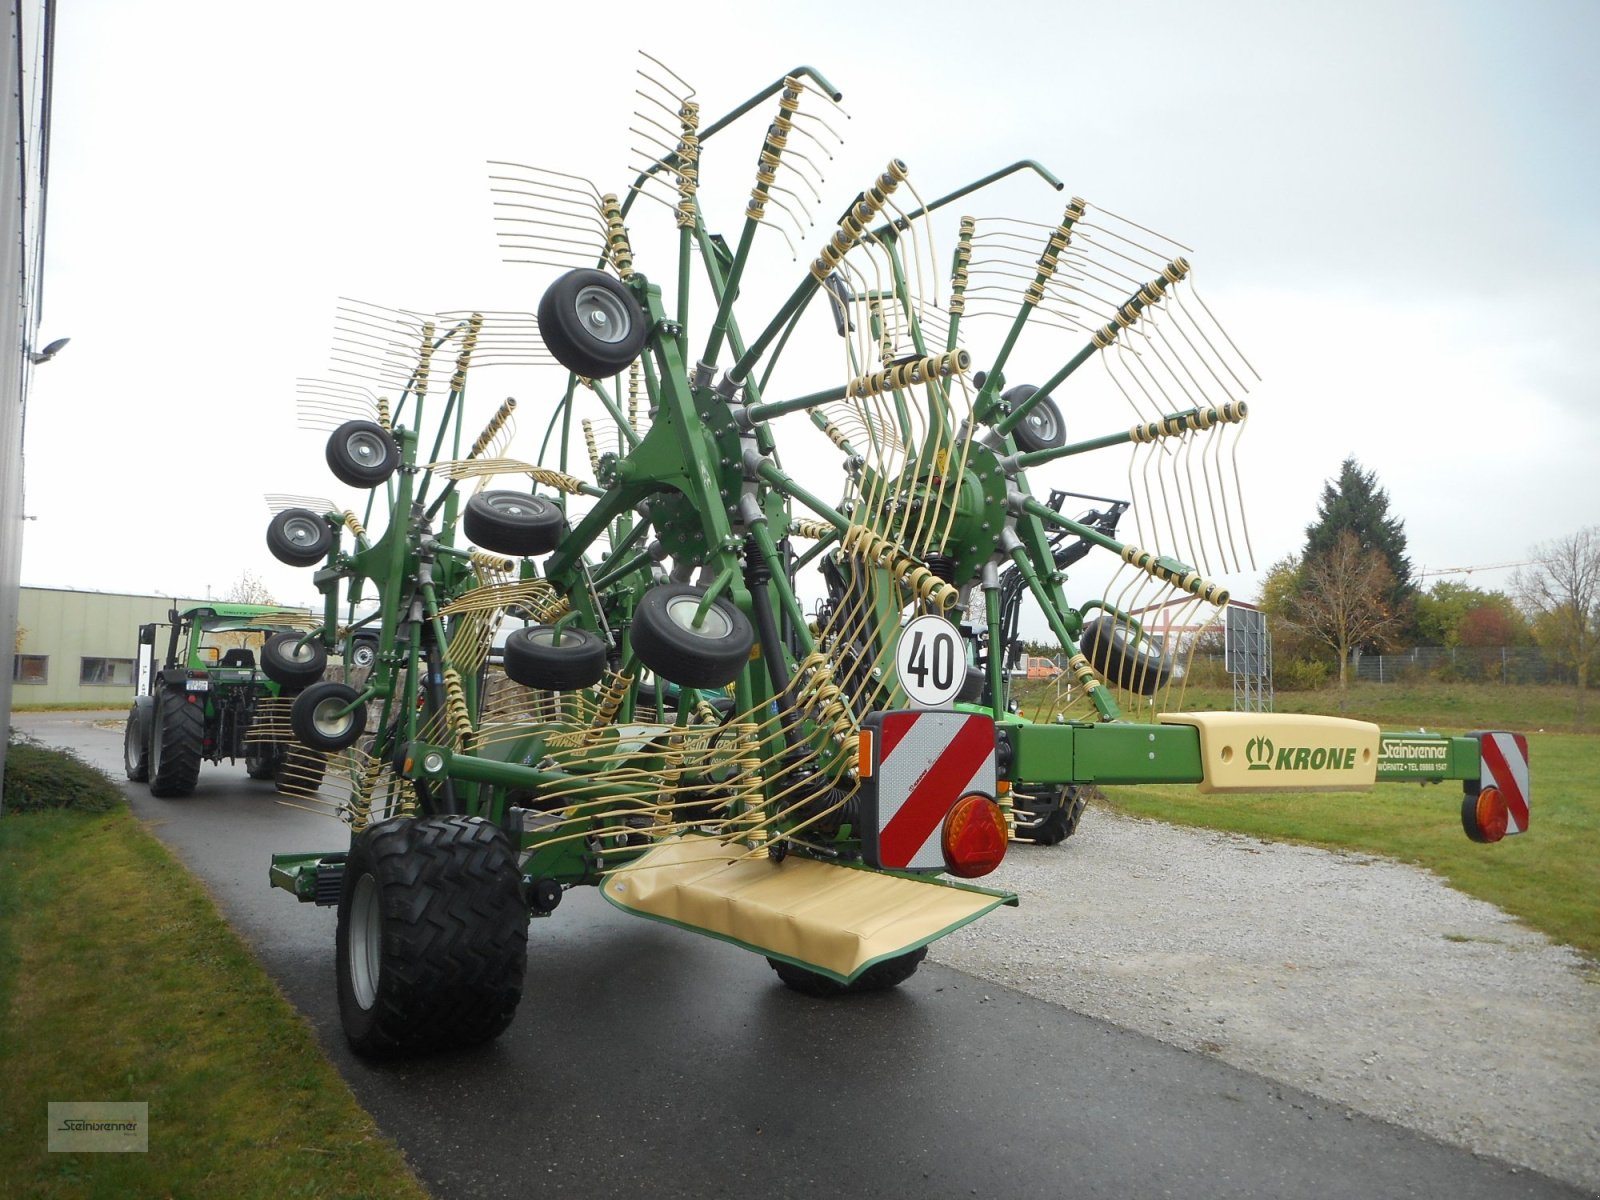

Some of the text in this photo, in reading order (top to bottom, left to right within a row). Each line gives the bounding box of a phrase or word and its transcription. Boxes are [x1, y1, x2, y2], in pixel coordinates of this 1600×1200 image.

[907, 631, 954, 690] 40
[1275, 747, 1357, 770] KRONE
[1378, 739, 1449, 759] Steinbrenner
